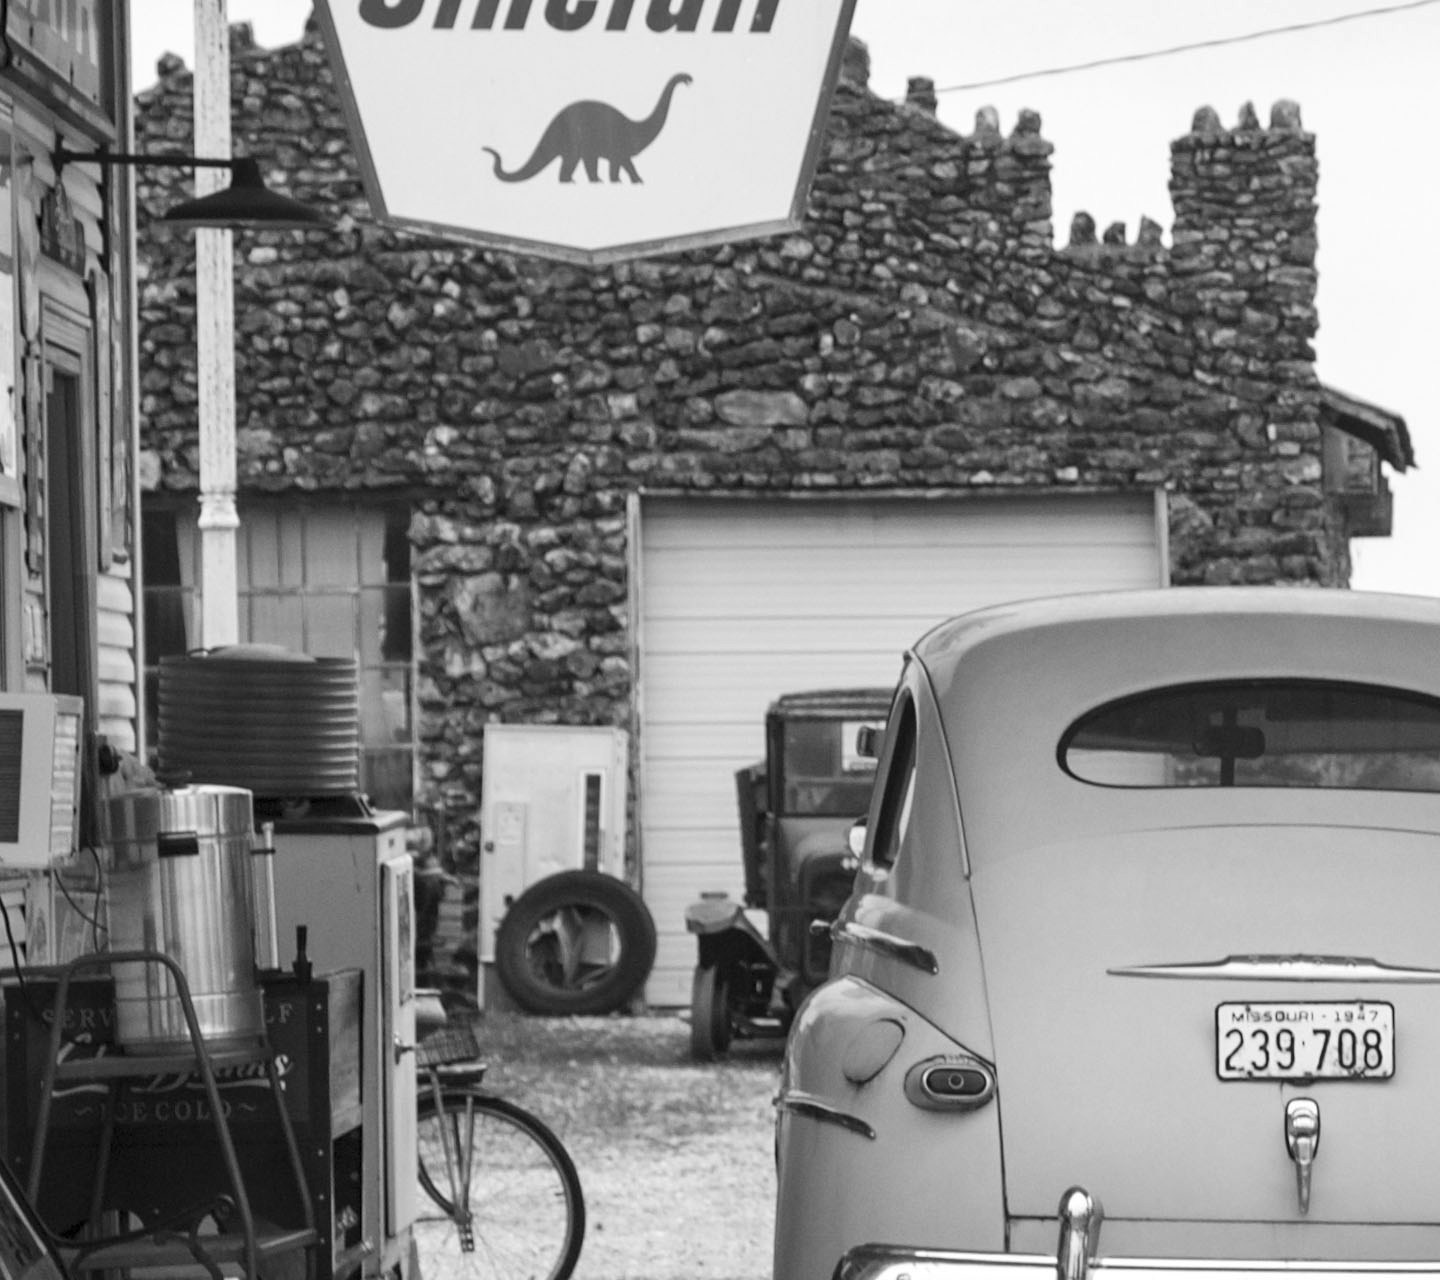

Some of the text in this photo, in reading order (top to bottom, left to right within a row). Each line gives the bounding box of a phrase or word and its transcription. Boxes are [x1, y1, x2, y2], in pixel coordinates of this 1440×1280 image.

[41, 1004, 115, 1031] SERV
[1231, 1010, 1379, 1023] MISSOURI 1947
[1224, 1028, 1383, 1072] 239 708
